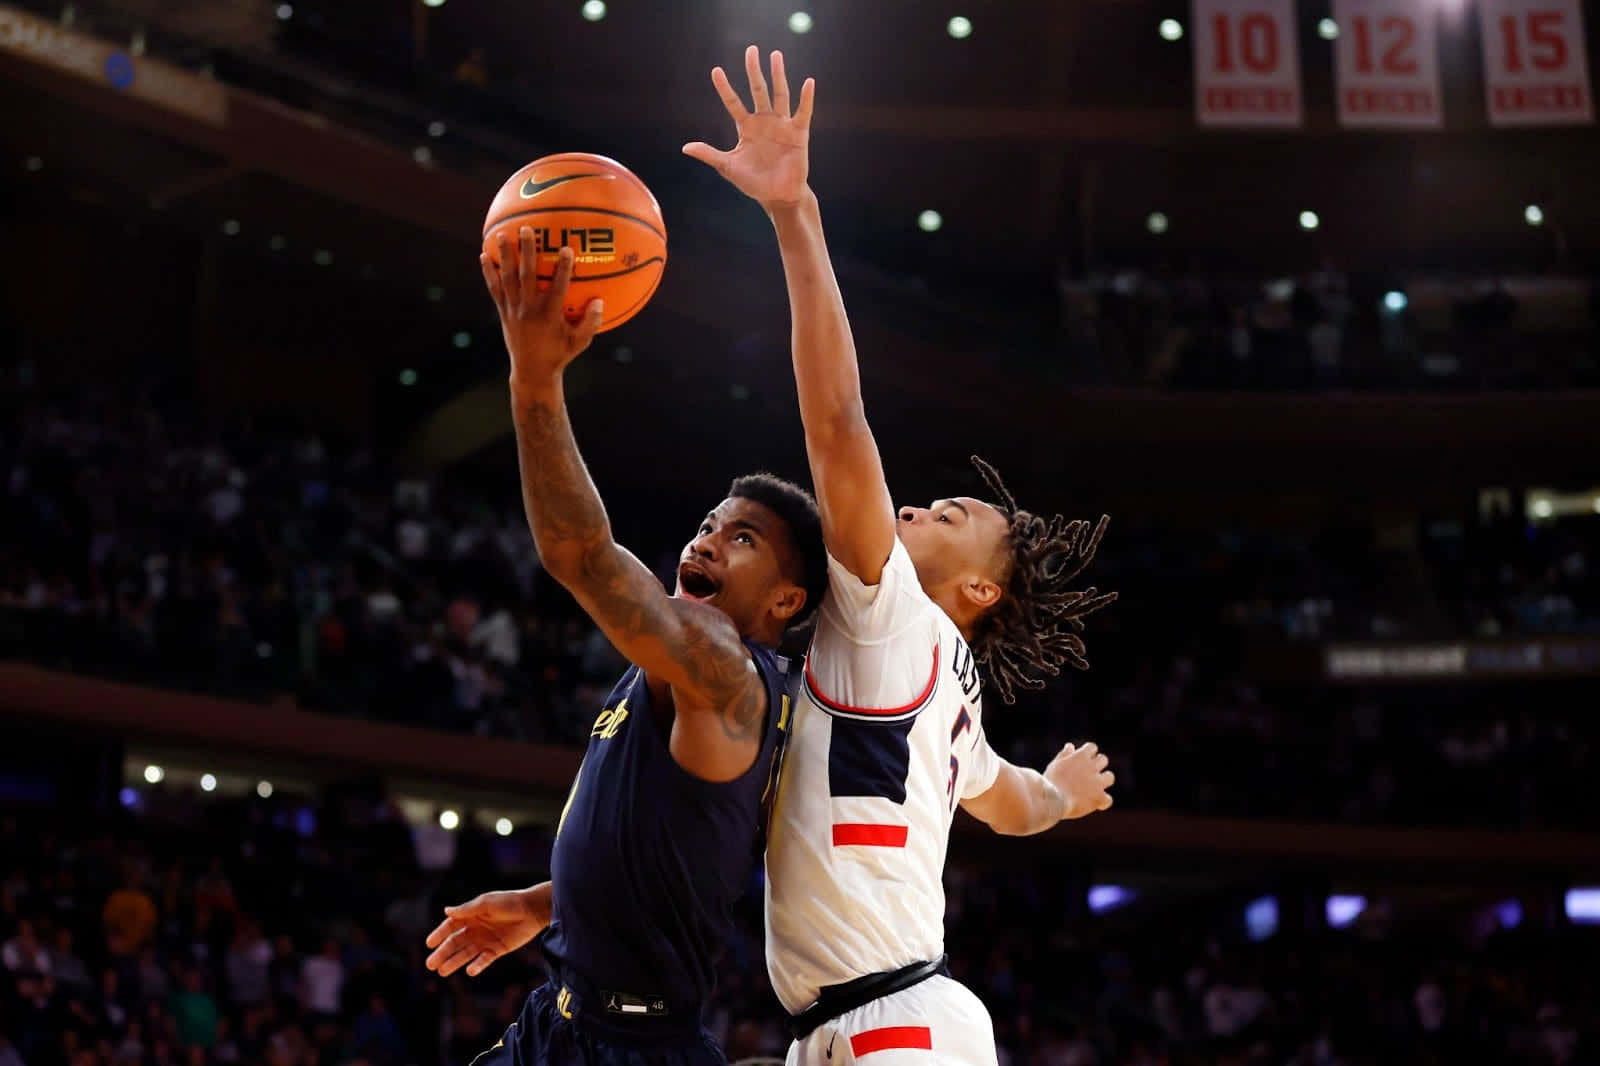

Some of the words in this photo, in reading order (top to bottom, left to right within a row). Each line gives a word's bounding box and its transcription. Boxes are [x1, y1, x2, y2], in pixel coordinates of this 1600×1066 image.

[1209, 12, 1279, 75] 10
[1351, 15, 1419, 75] 12
[1498, 10, 1568, 75] 15
